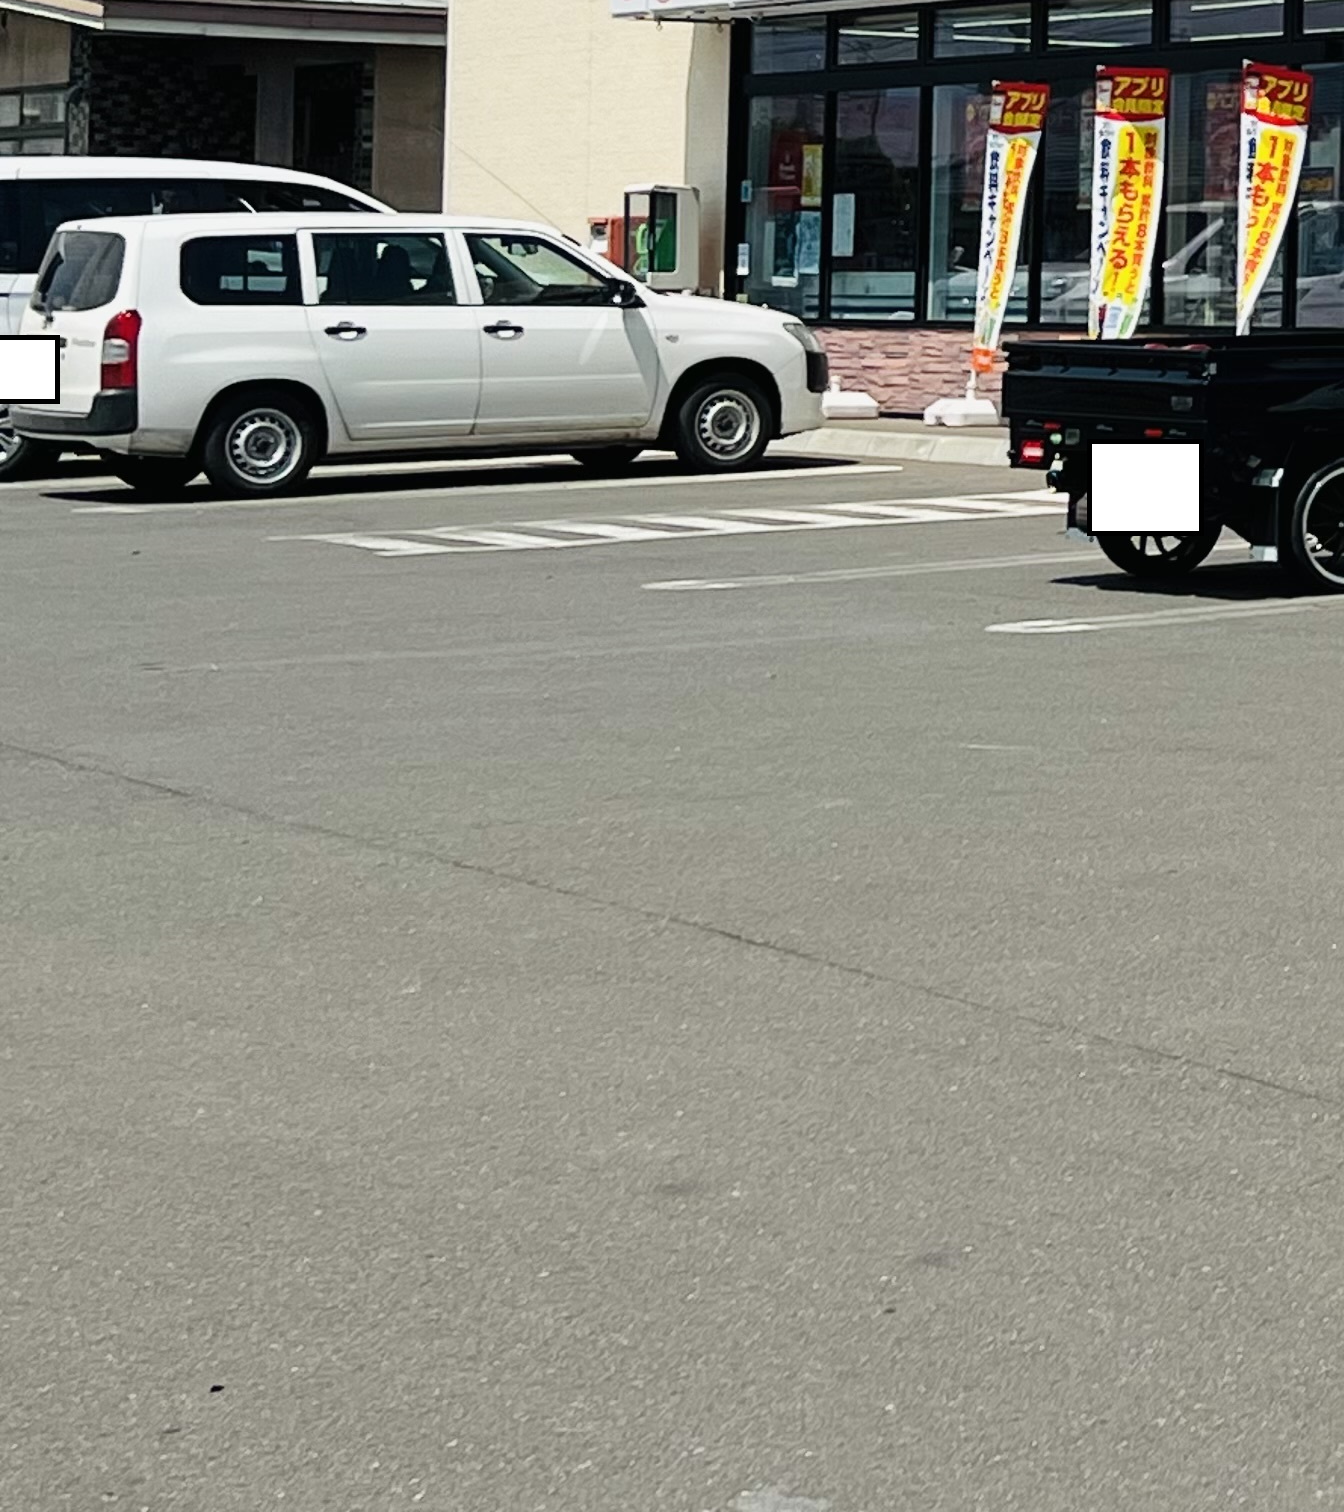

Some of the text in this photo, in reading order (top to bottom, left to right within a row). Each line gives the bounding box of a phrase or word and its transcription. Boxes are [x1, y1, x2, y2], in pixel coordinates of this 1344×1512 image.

[1113, 76, 1165, 97] アプリ
[1262, 75, 1308, 102] アプリ
[1005, 90, 1047, 111] アプリ
